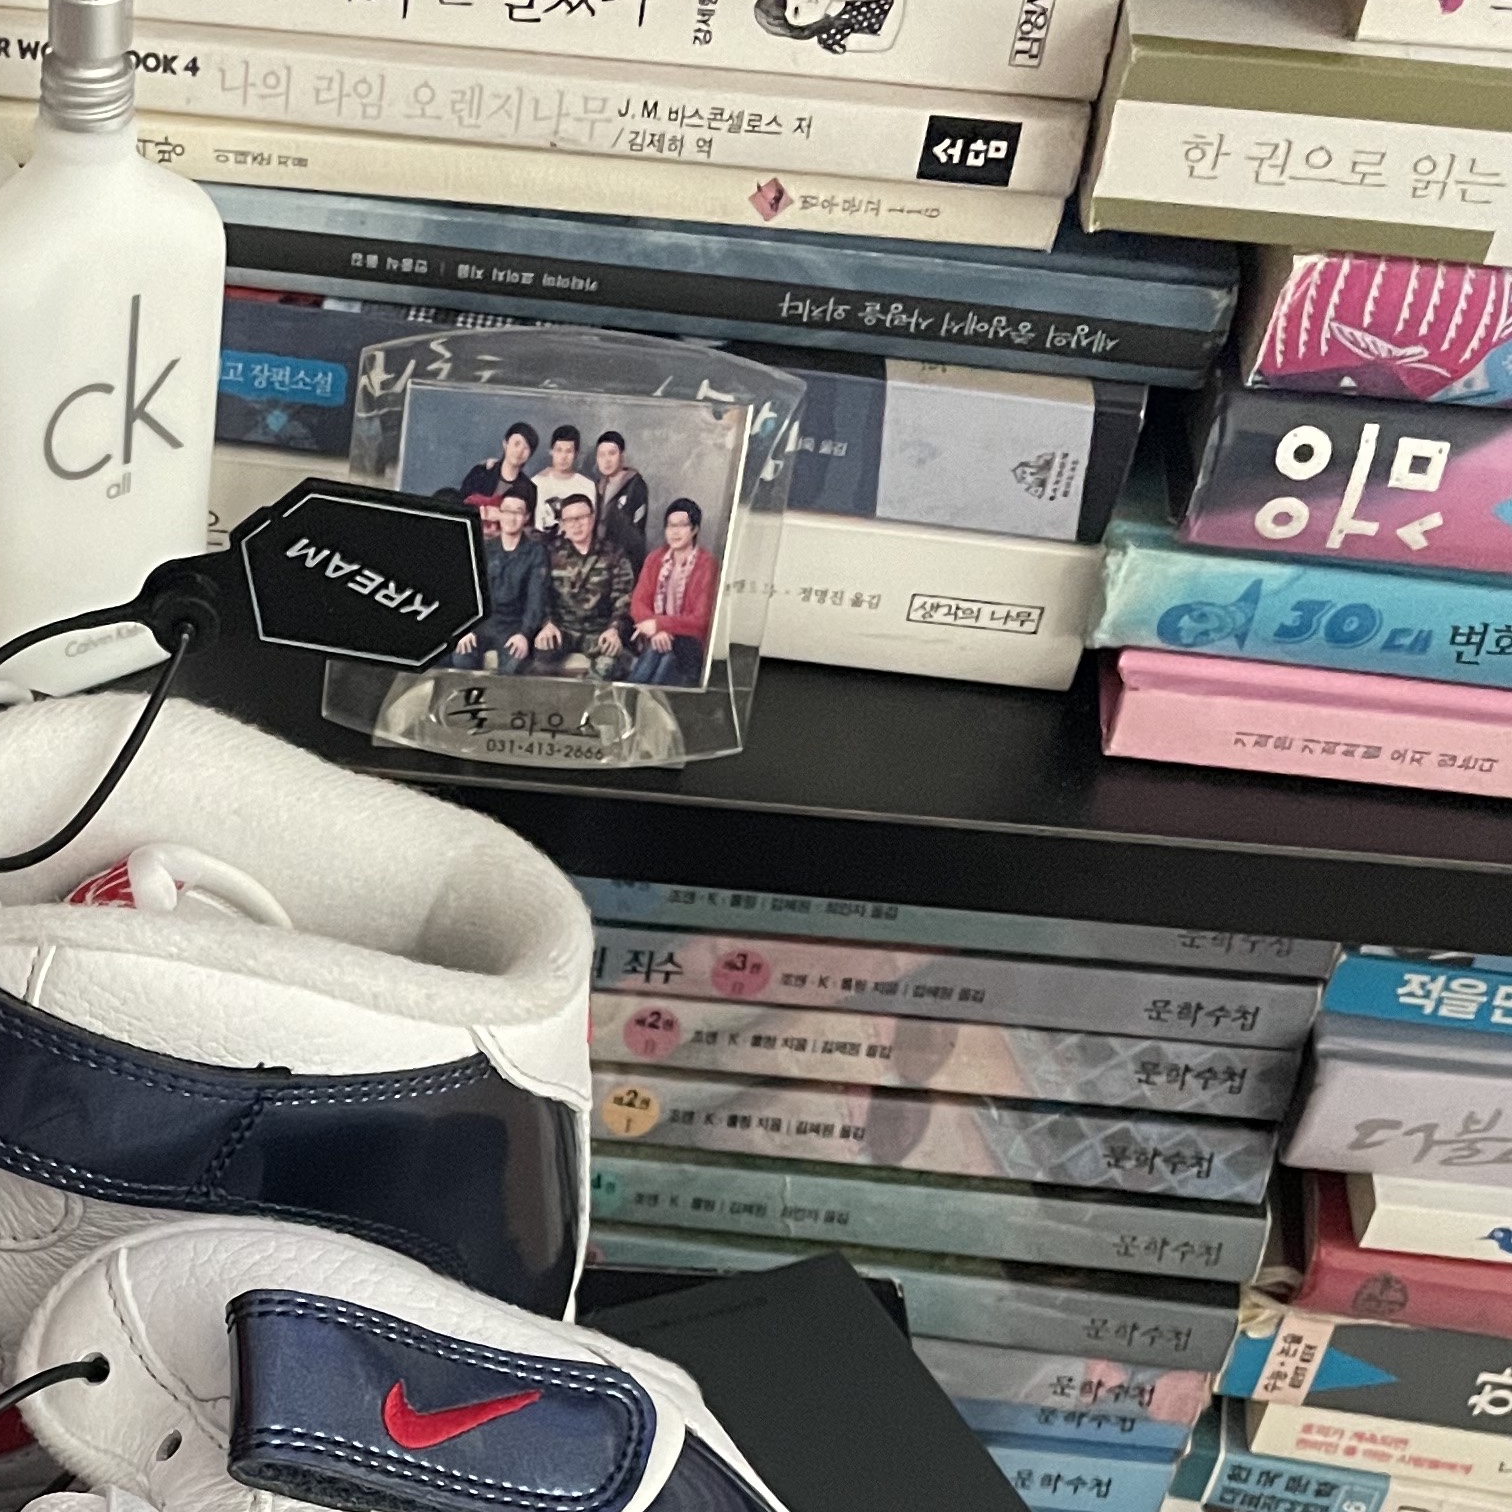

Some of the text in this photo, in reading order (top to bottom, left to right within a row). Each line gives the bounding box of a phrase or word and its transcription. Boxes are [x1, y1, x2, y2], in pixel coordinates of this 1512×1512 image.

[183, 55, 200, 77] 4
[219, 60, 612, 139] 나의 라임 오렌지나무
[668, 104, 783, 135] 바스콘셀로스
[792, 115, 813, 139] 저
[696, 137, 713, 159] 역
[931, 137, 1008, 165] 소담
[1182, 132, 1506, 204] 한 권으로 읽는
[779, 292, 1119, 354] 세상의 중심에서 사랑을 외치다
[43, 294, 184, 481] ck
[250, 364, 333, 396] 장편소설
[106, 473, 131, 500] all
[286, 536, 440, 622] KREAM
[913, 600, 1036, 628] 생각의 나무
[622, 949, 683, 984] 죄수
[1396, 973, 1488, 1019] 적을
[1144, 999, 1262, 1031] 문학수첩
[1134, 1061, 1248, 1095] 문학수첩
[1103, 1145, 1214, 1179] 문학수첩
[1113, 1235, 1223, 1266] 문학수첩
[1083, 1318, 1192, 1352] 문학수첩
[1049, 1375, 1156, 1408] 문학수첩
[1013, 1469, 1113, 1499] 문학수첩
